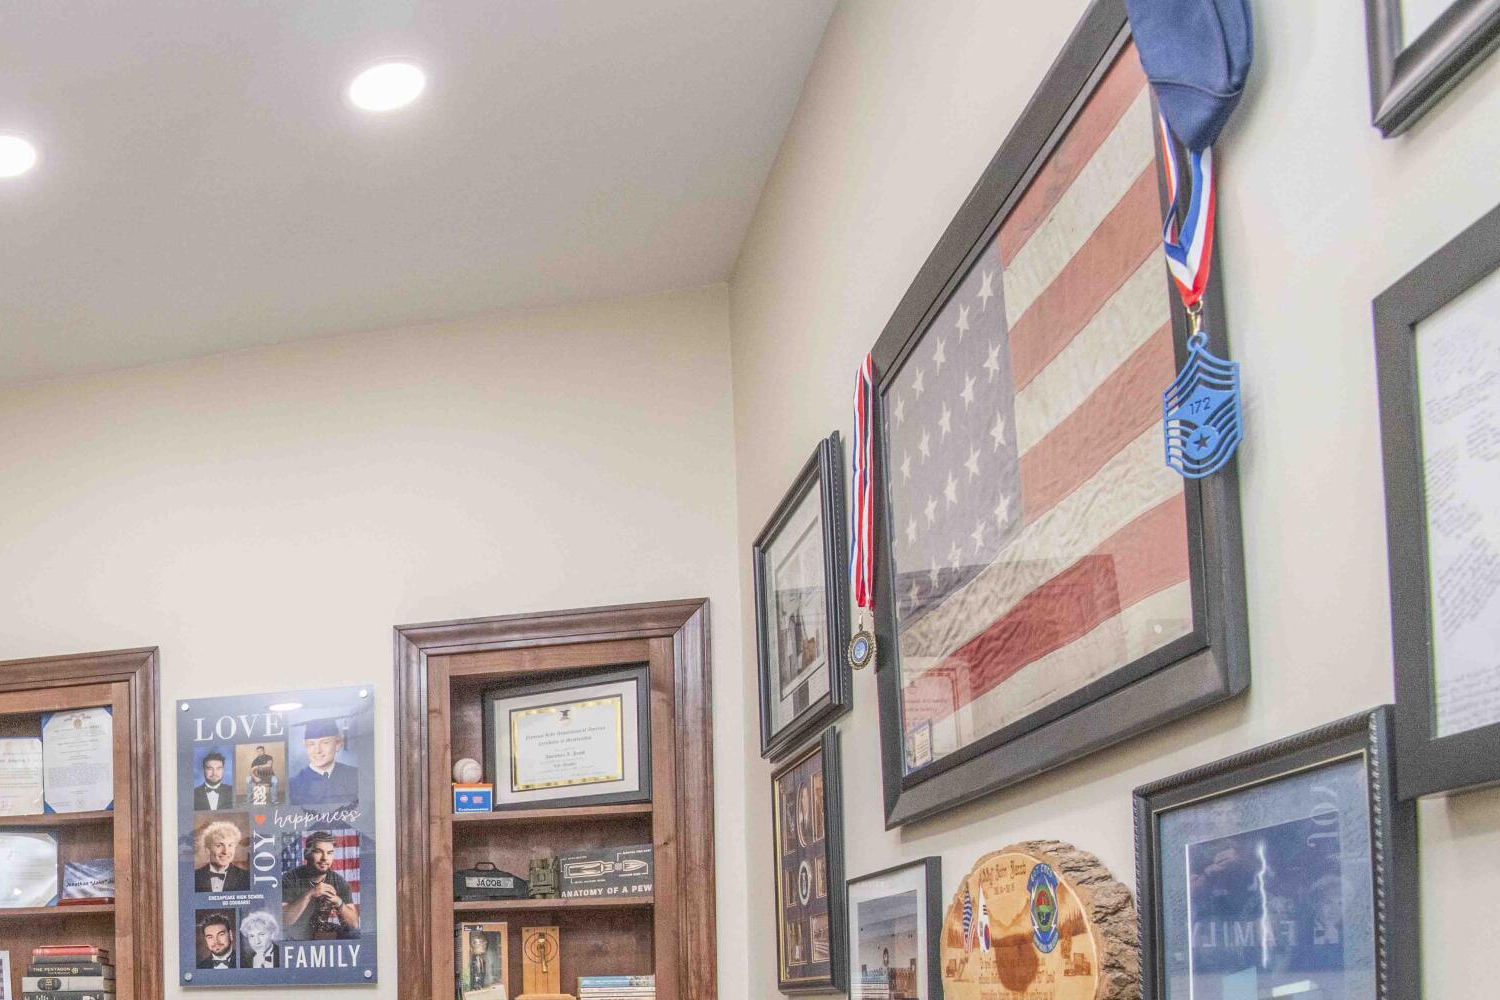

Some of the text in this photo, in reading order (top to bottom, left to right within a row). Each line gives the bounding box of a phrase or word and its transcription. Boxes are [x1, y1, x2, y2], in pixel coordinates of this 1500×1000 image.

[1190, 397, 1211, 415] 172
[193, 713, 285, 742] LOVE
[274, 808, 361, 831] happiness
[254, 829, 278, 888] JOY
[476, 879, 502, 887] JACOB
[561, 887, 604, 898] ANATOMY
[607, 886, 619, 894] OF
[632, 884, 652, 893] PEW
[284, 945, 361, 968] FAMILY
